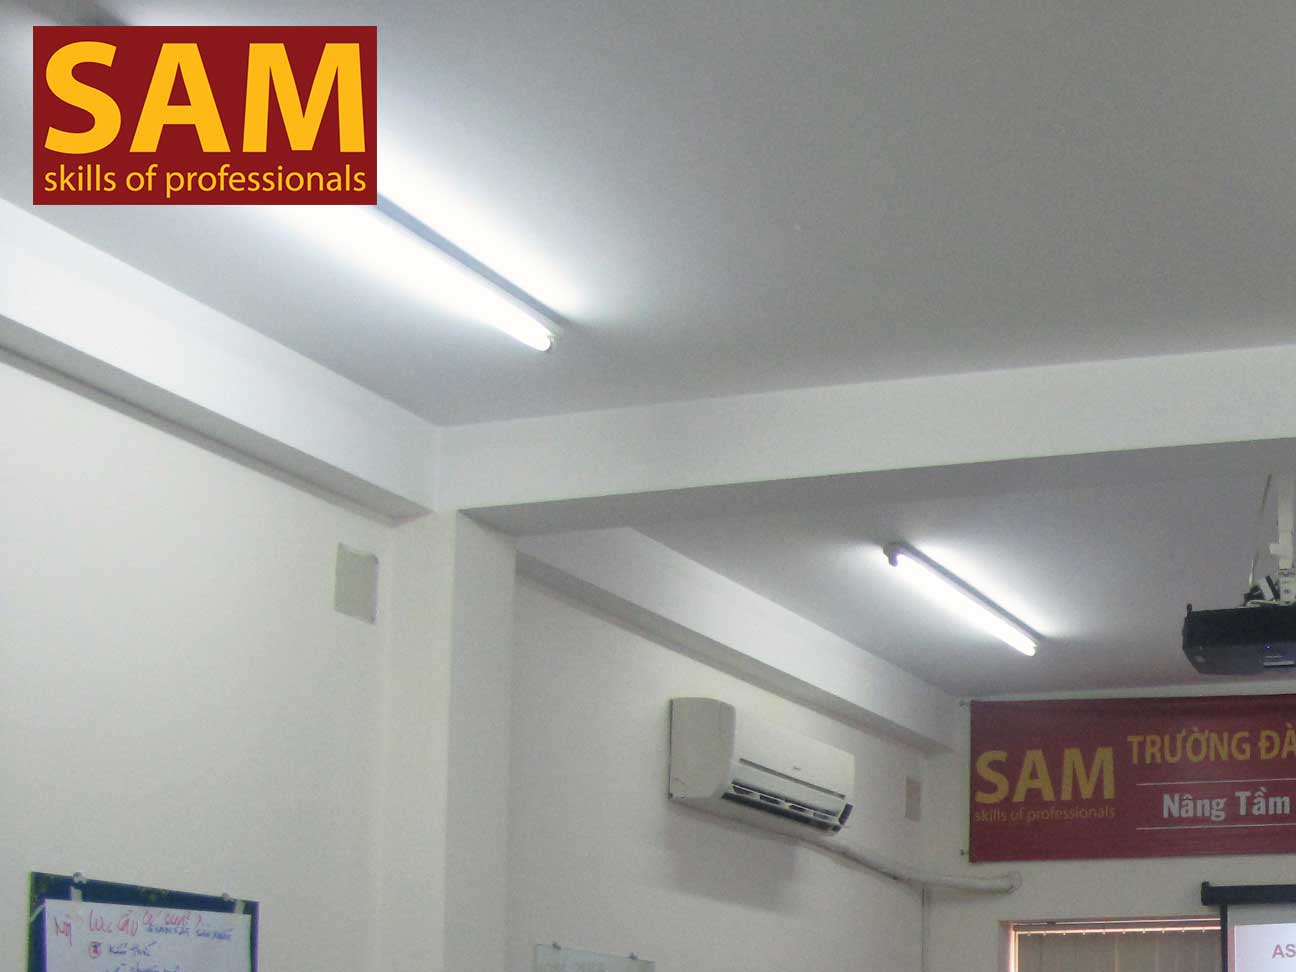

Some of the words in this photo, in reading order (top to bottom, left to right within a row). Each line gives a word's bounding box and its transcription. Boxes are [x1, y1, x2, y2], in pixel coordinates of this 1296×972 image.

[1127, 726, 1250, 764] TRƯỜNG
[975, 746, 1117, 804] SAM
[975, 807, 1007, 823] skills
[1010, 807, 1025, 822] of
[1027, 806, 1116, 823] professionals
[1163, 793, 1228, 821] Nâng
[1235, 786, 1291, 816] Tầm
